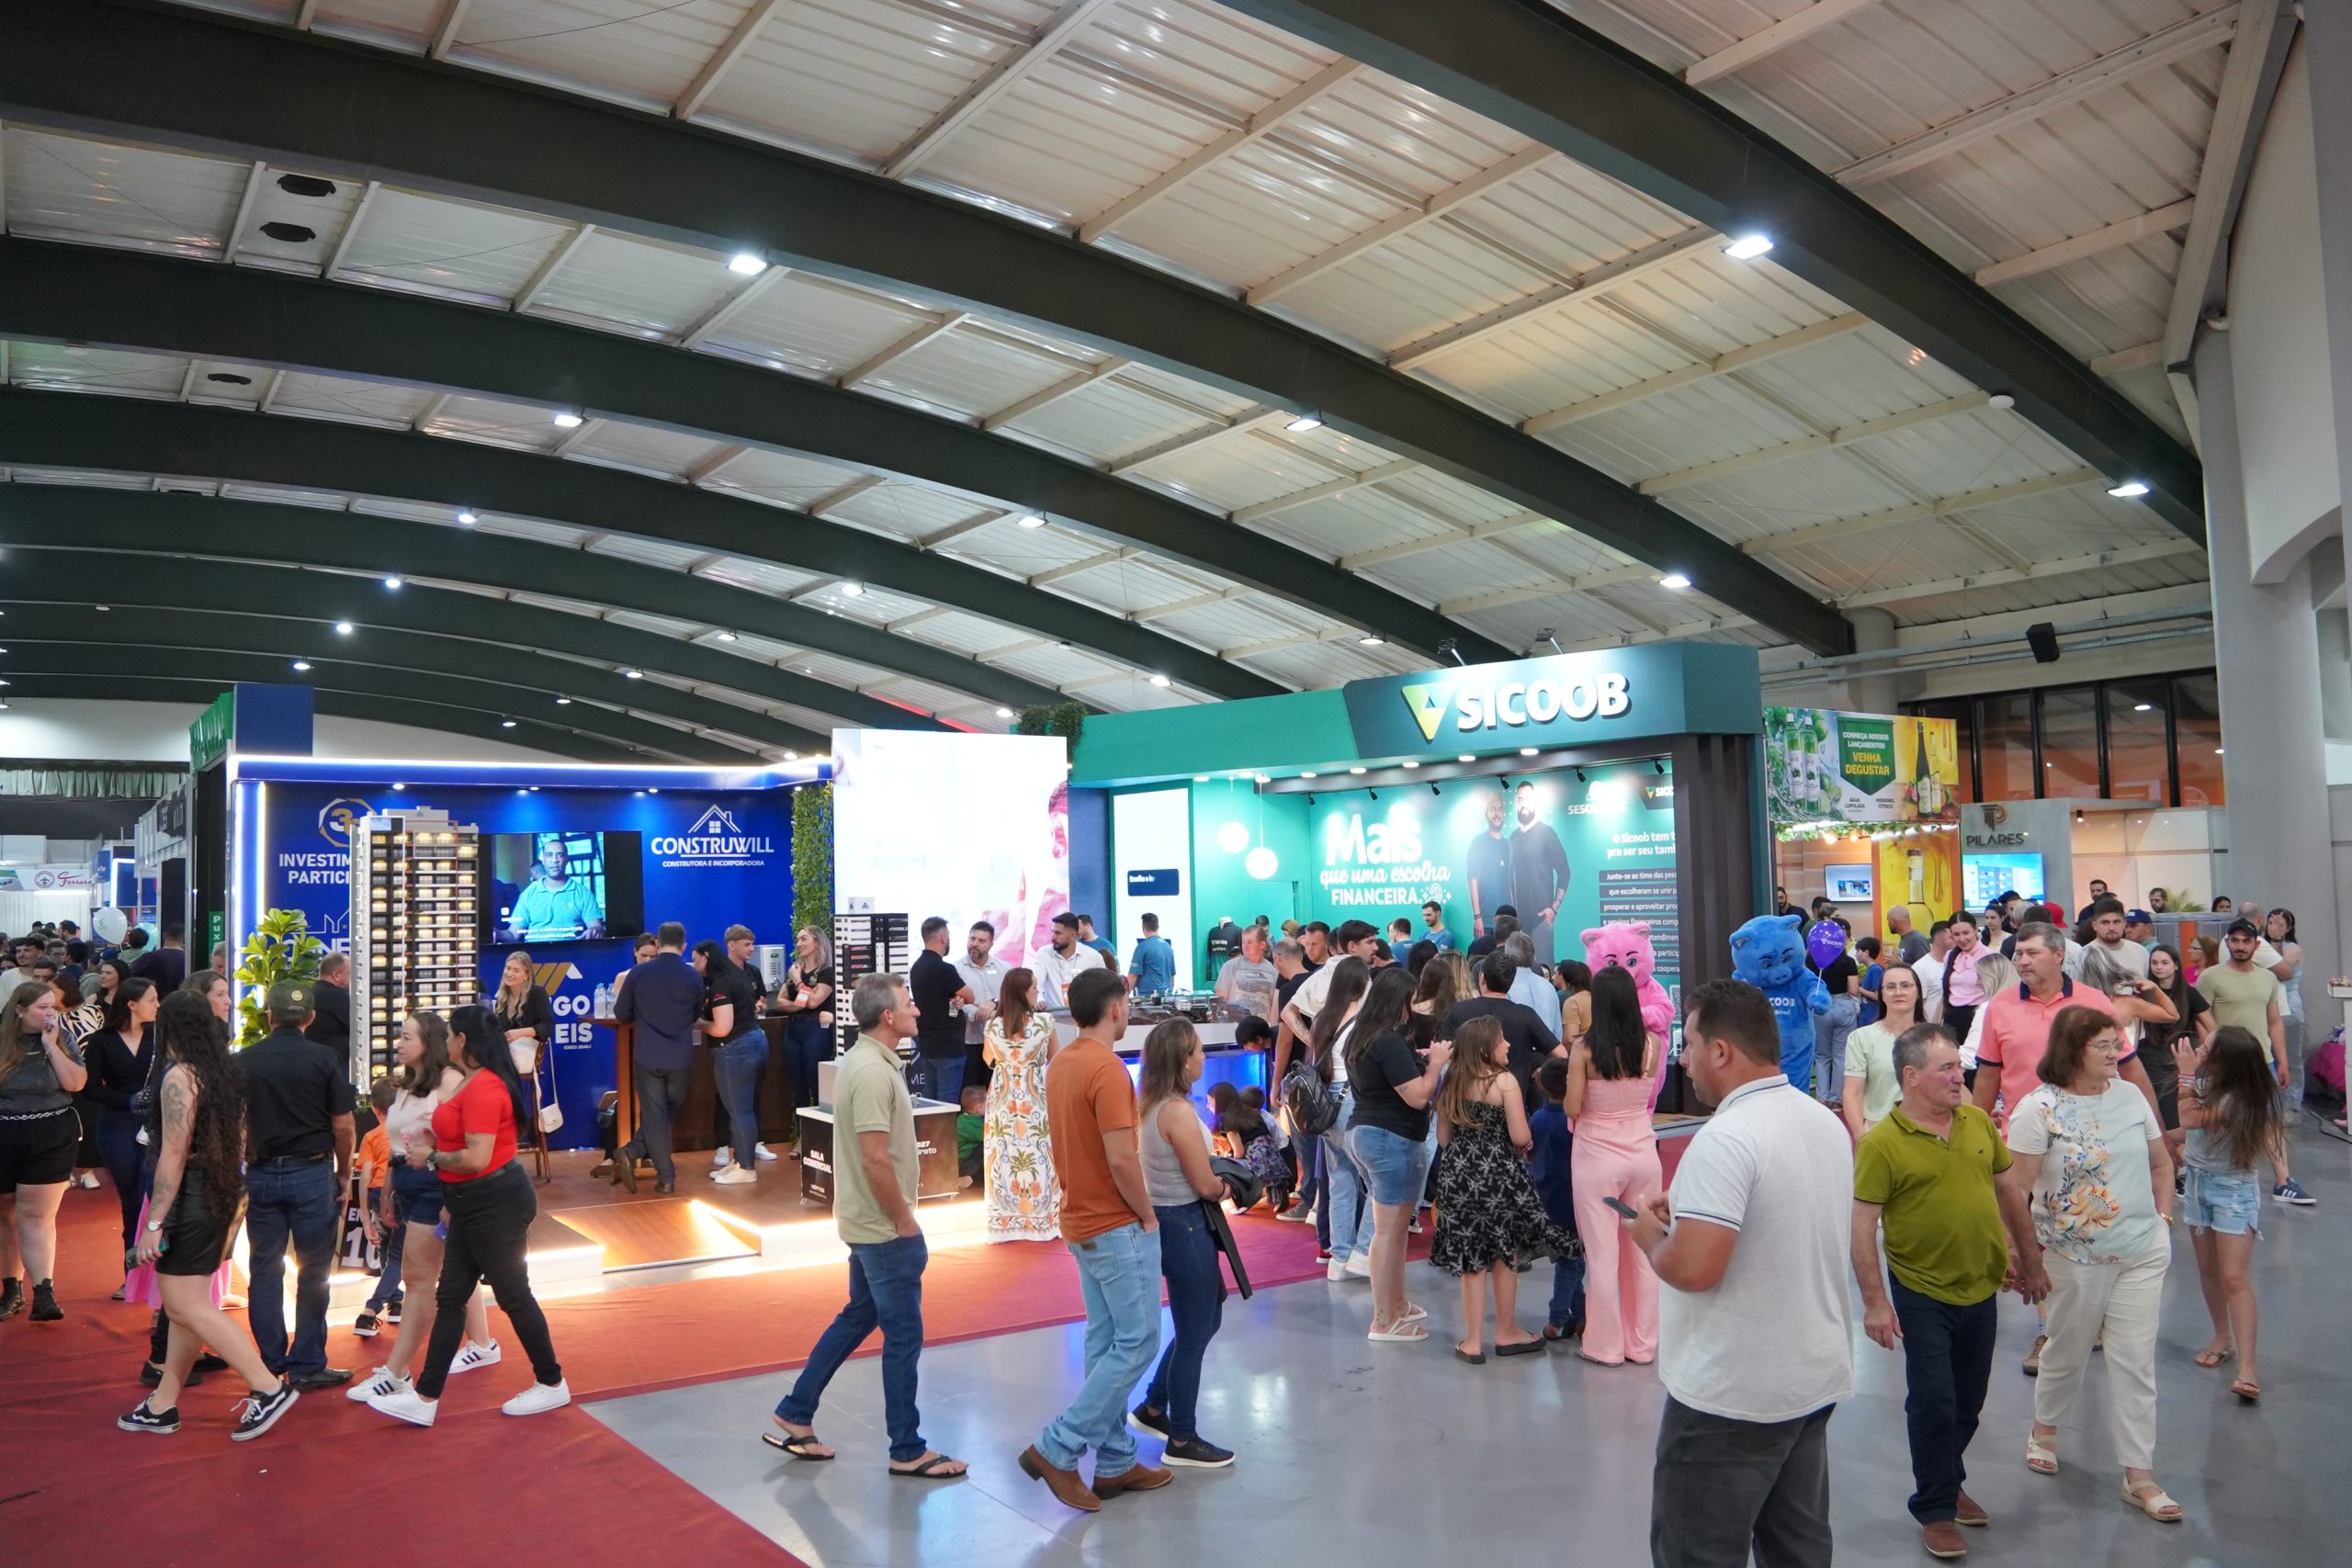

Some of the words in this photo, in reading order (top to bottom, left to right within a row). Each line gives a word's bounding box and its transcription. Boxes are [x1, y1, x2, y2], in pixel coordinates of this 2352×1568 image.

[1456, 672, 1630, 729] SICOOB
[1852, 751, 1882, 763] VENHA
[1845, 764, 1890, 775] DEGUSTAR
[1325, 805, 1423, 866] Mais
[1612, 833, 1620, 843] O
[1621, 831, 1649, 843] Sicoob
[1651, 832, 1668, 841] tem
[1966, 832, 2024, 846] PILARES
[650, 837, 775, 854] CONSTRUWILL
[278, 853, 350, 867] INVESTIM
[1607, 848, 1623, 860] pra
[1623, 847, 1637, 856] ser
[1638, 846, 1653, 855] seu
[288, 870, 350, 884] PARTICI
[1319, 866, 1349, 890] que
[1351, 866, 1387, 884] uma
[1390, 860, 1452, 883] escolha
[1653, 871, 1664, 879] das
[1331, 886, 1423, 906] FINANCEIRA.
[1608, 888, 1620, 897] que
[1620, 886, 1653, 896] escolheram
[1659, 886, 1672, 894] unir
[1603, 904, 1631, 912] prosperar
[1635, 902, 1665, 911] aproveitar
[1657, 965, 1680, 974] coopera
[548, 995, 591, 1017] GO
[1769, 997, 1795, 1007] COOB
[555, 1021, 594, 1044] EIS
